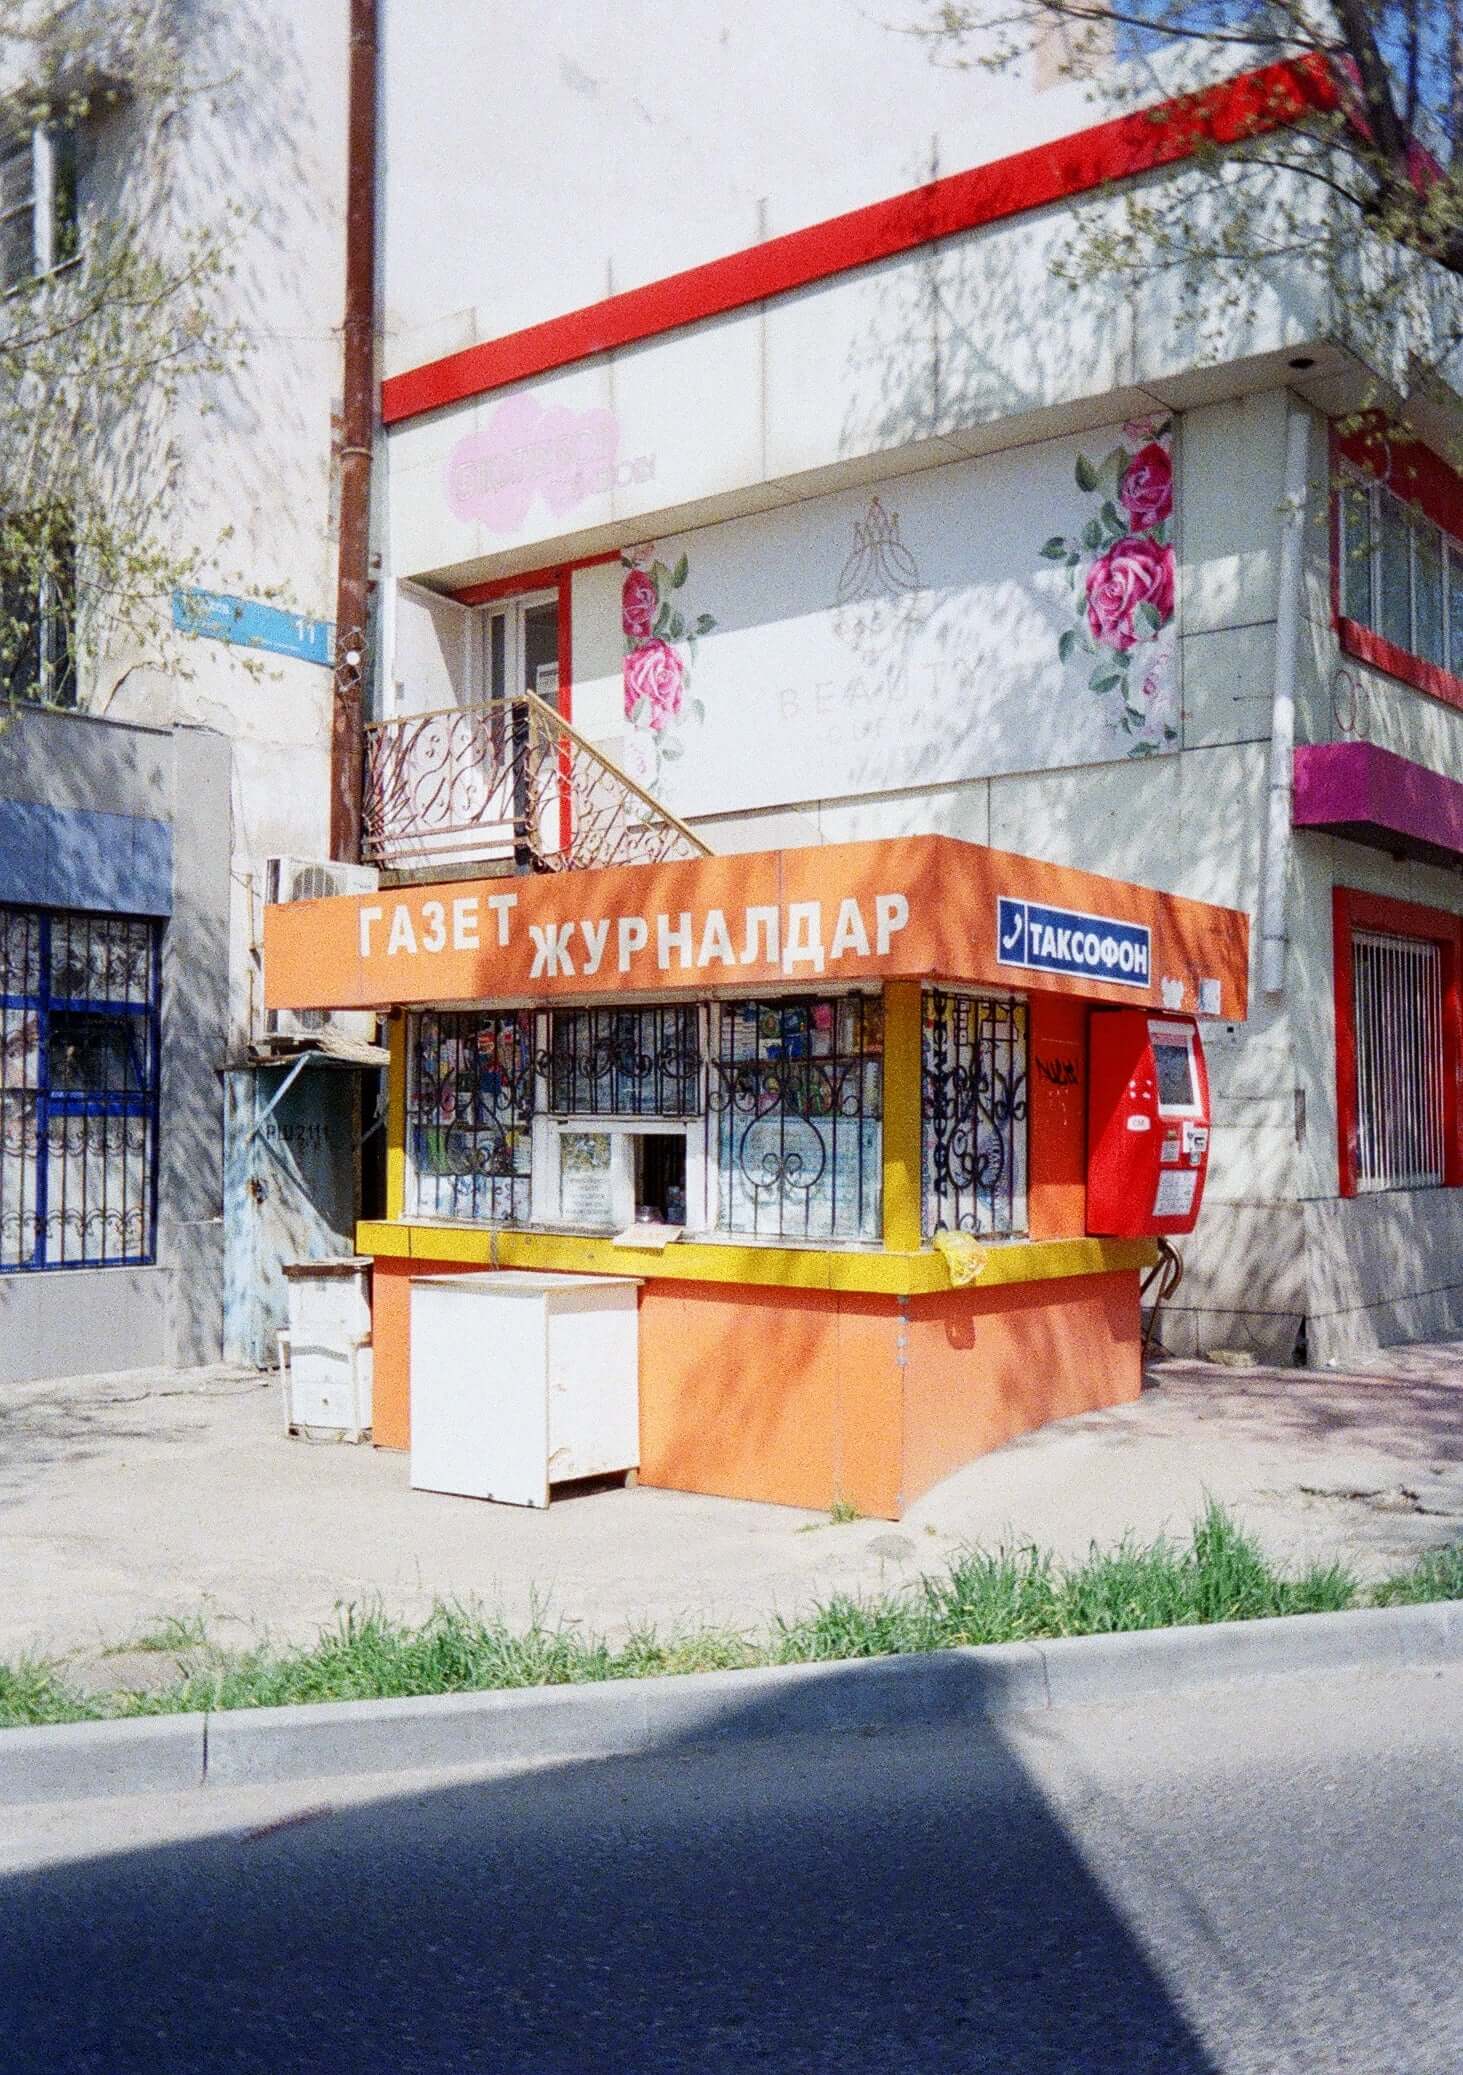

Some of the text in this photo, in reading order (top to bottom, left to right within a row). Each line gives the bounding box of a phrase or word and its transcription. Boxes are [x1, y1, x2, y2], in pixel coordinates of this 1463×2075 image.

[295, 619, 316, 645] 11
[359, 893, 910, 979] ГАЗЕТ ЖУРНАЛДАР
[1030, 922, 1148, 975] ТАКСОФОН
